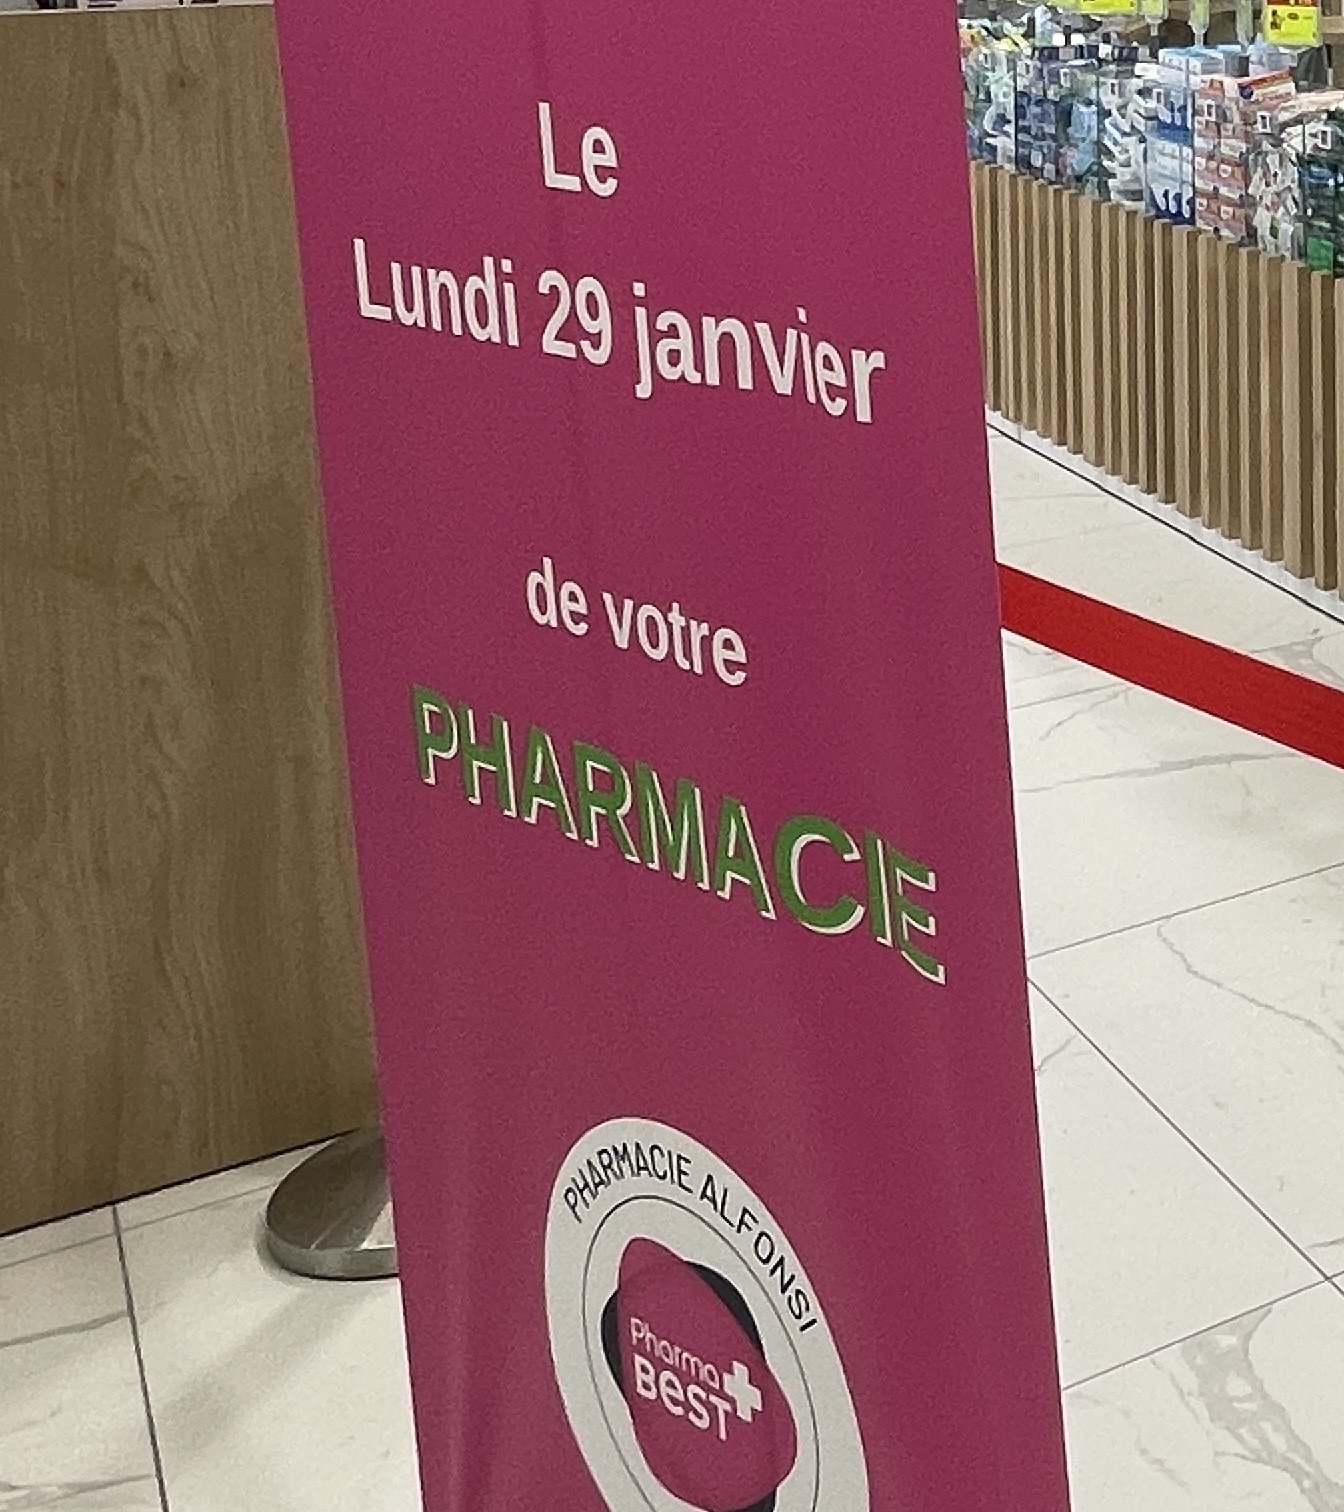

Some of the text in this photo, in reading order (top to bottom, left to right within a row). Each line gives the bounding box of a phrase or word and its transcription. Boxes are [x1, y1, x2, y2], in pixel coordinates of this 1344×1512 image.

[538, 101, 619, 198] Le
[353, 238, 886, 426] Lundi 29 janvier
[525, 556, 748, 686] de votre
[412, 684, 947, 986] PHARMACIE
[563, 1141, 817, 1334] PHARMACIE ALFONSI
[630, 1315, 720, 1388] Pharma
